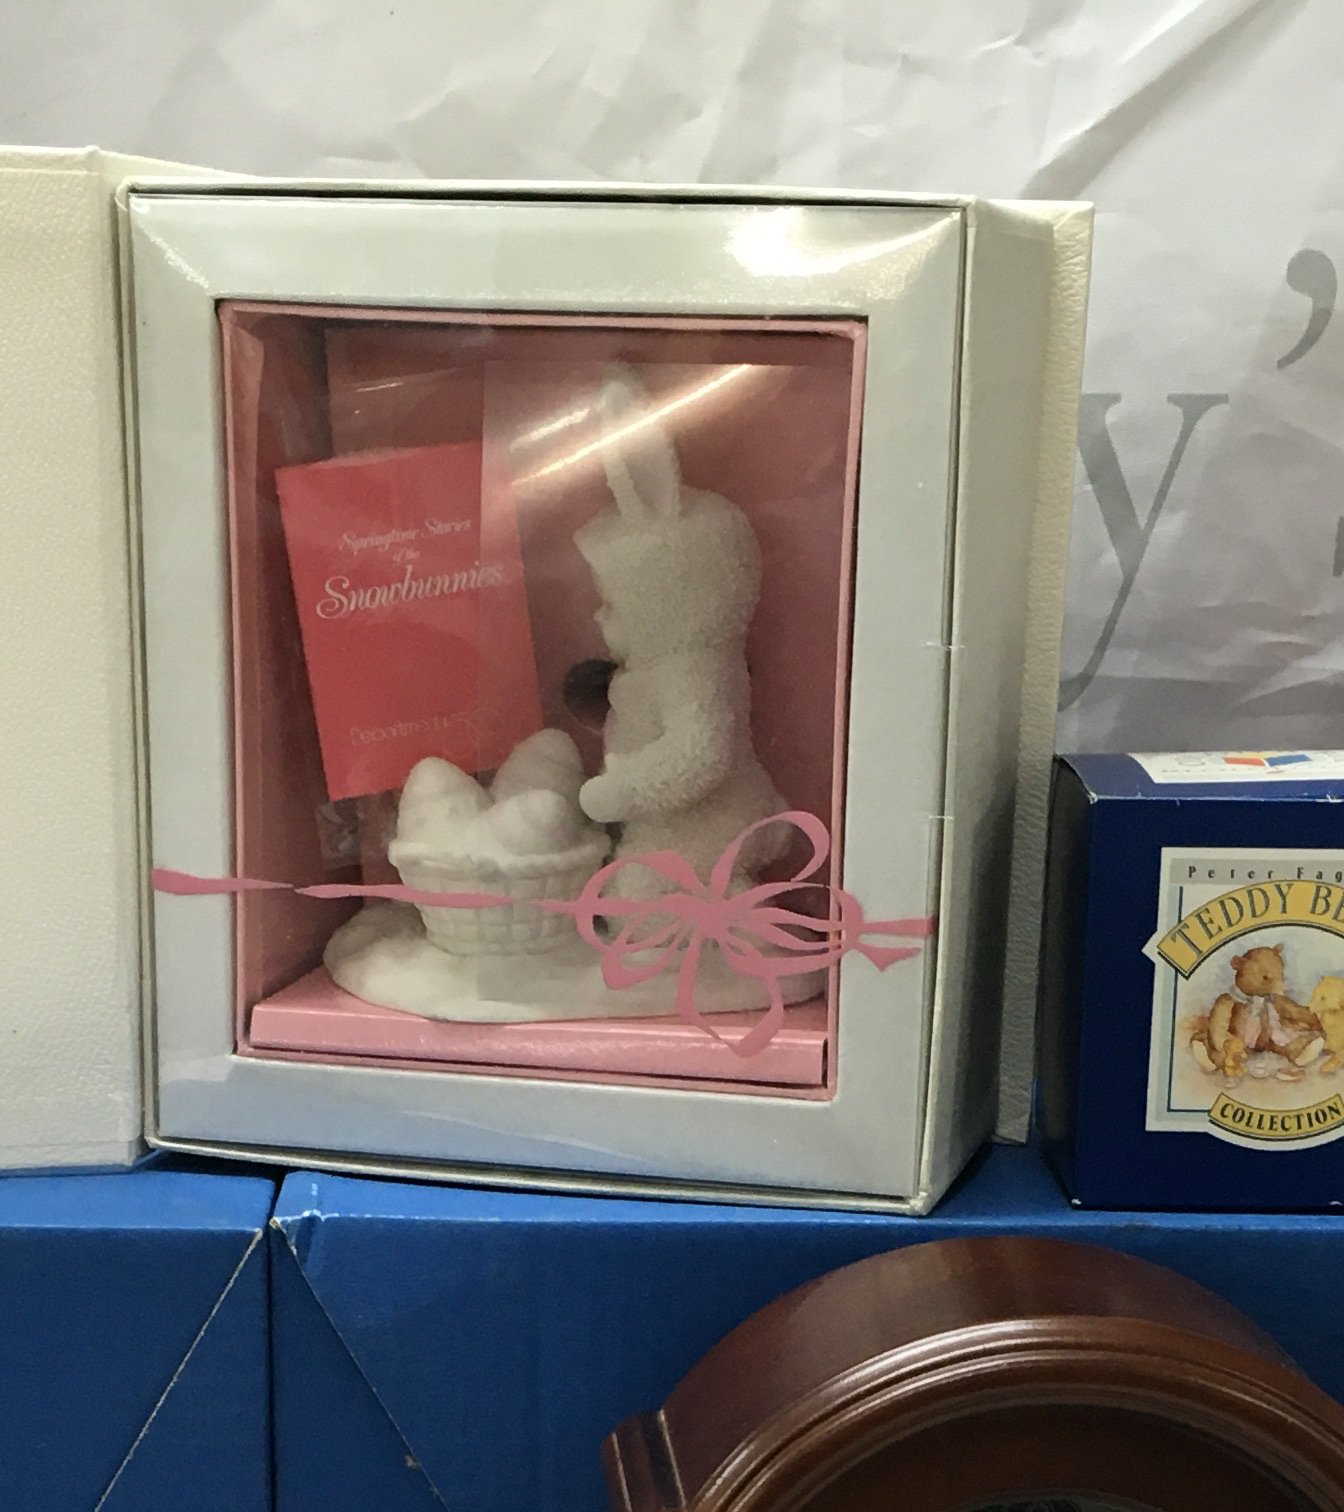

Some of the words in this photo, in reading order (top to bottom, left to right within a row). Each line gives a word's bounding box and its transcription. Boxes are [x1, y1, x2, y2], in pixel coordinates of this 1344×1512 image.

[1188, 864, 1274, 880] Peter
[1170, 882, 1295, 958] TEDDY
[1219, 1100, 1342, 1132] COLLECTION
